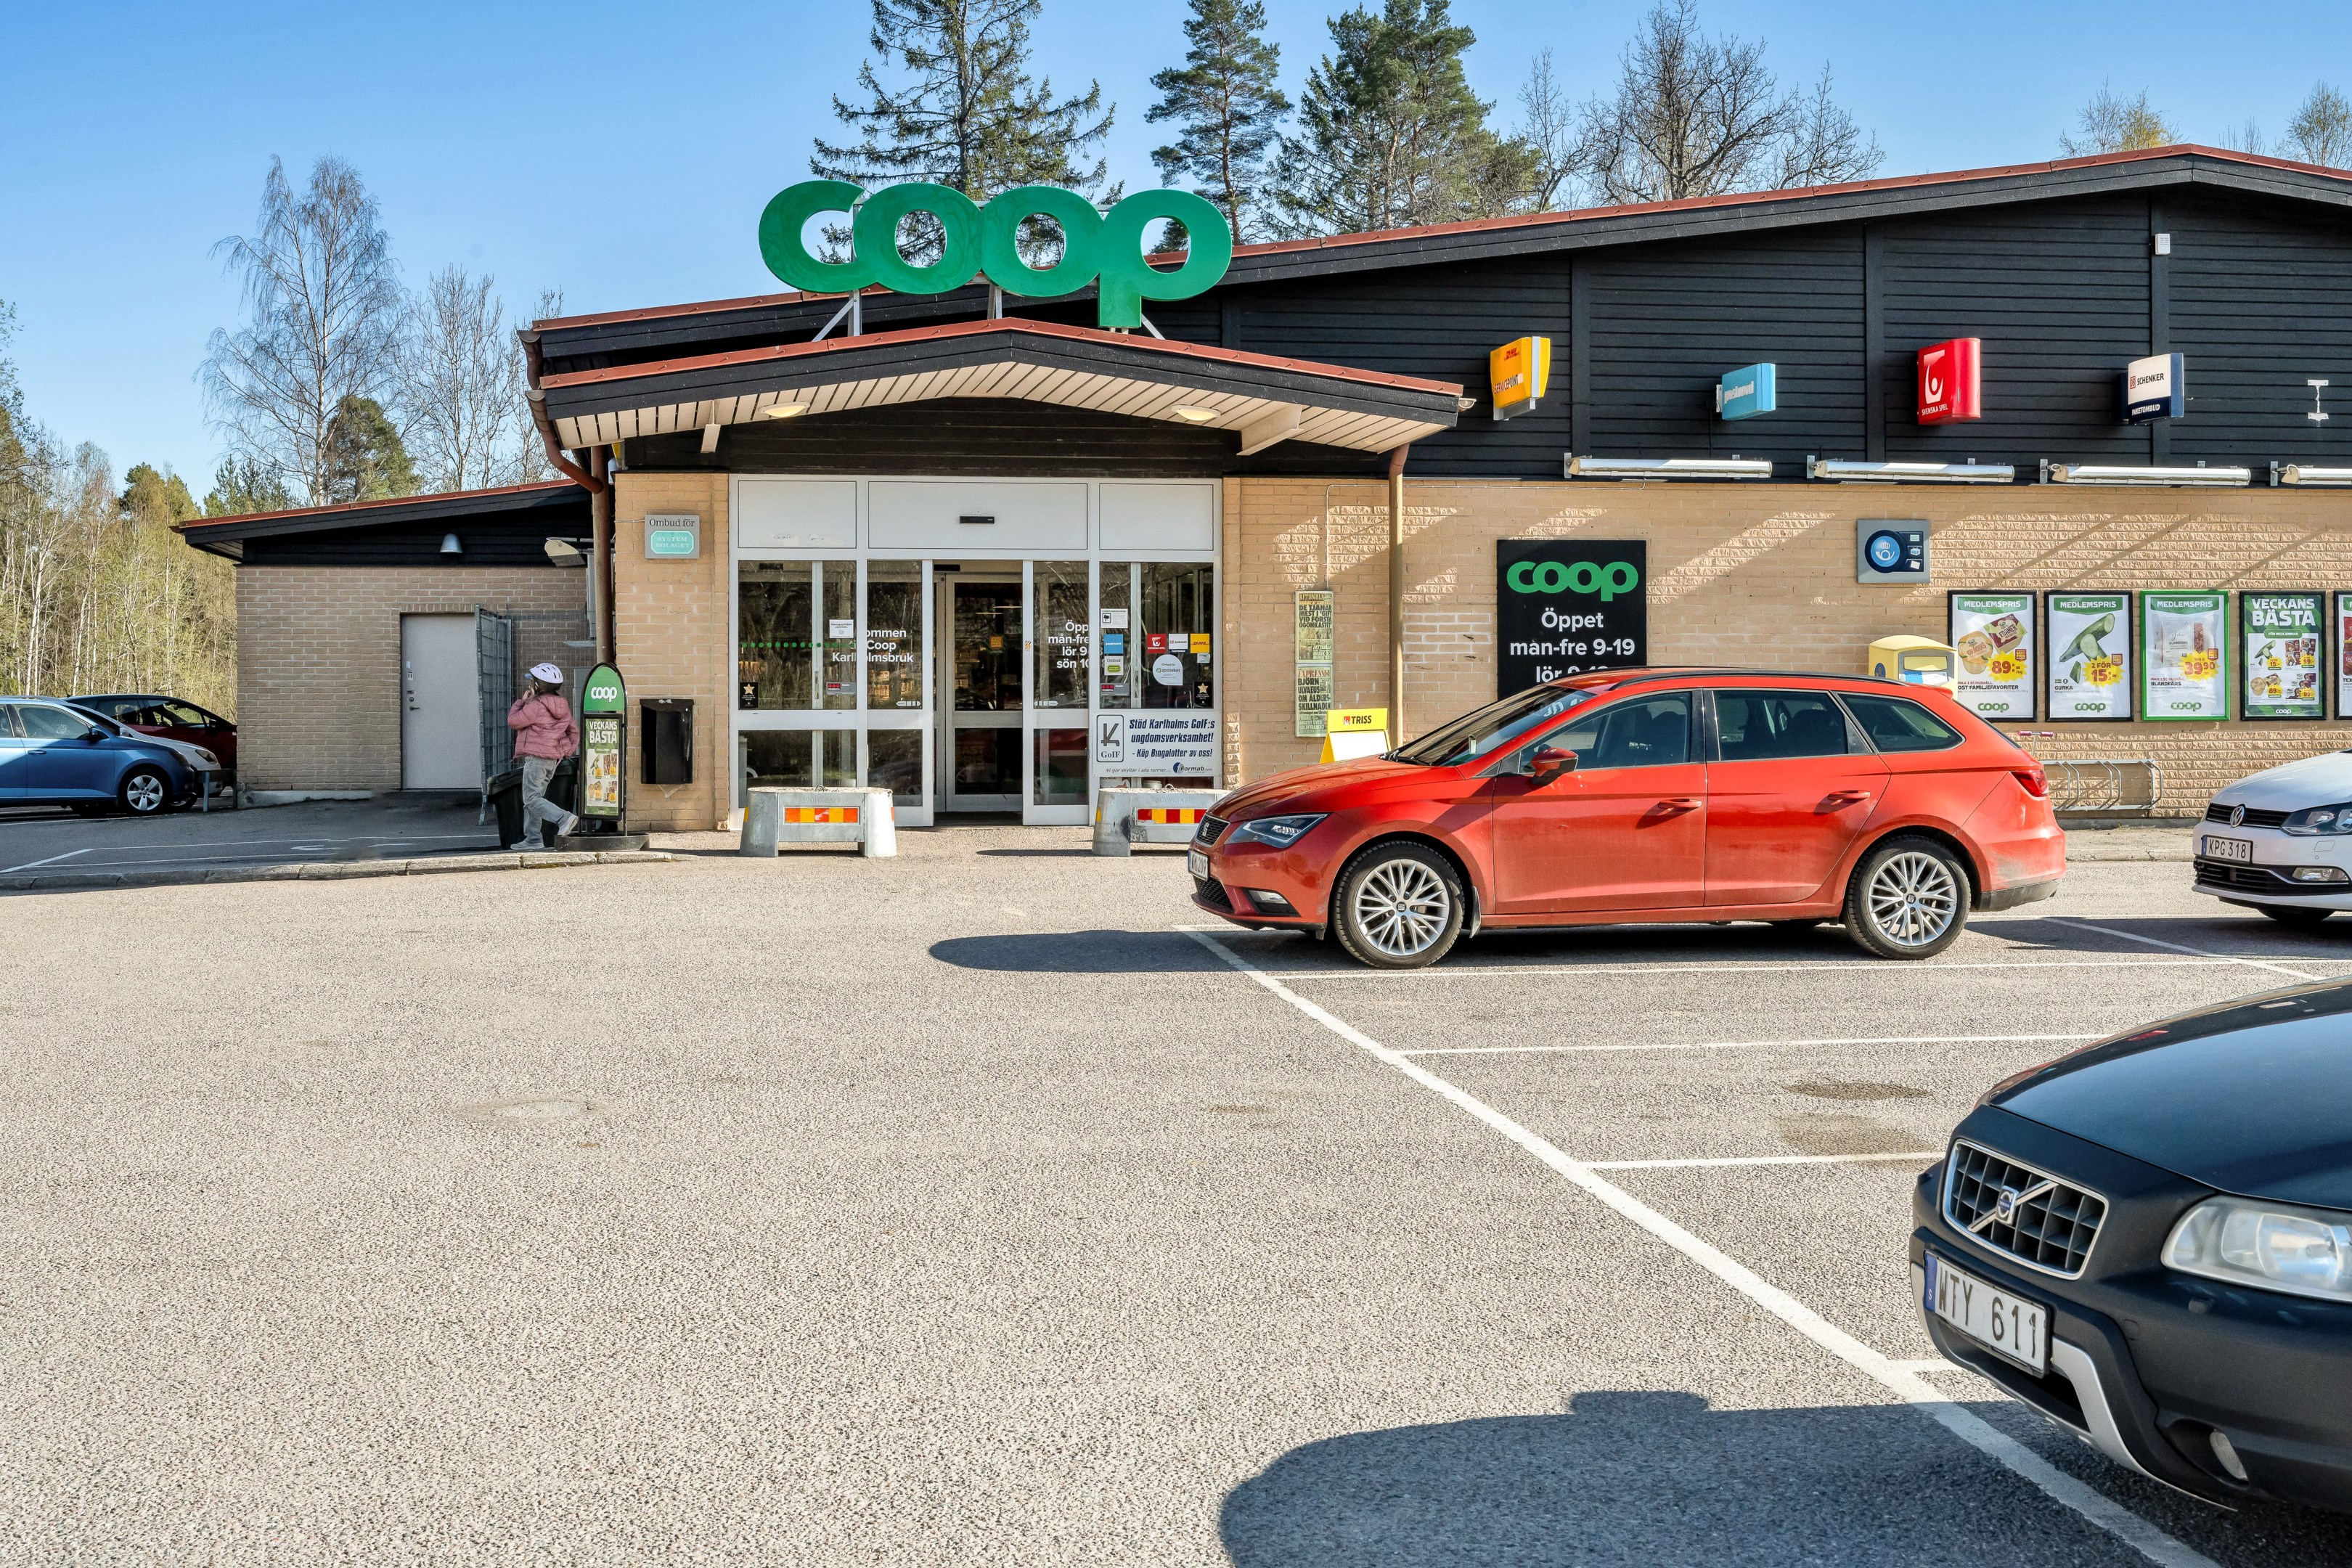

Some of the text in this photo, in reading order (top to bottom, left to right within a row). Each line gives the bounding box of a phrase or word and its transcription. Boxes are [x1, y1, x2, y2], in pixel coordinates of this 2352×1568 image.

[759, 180, 1232, 327] coop
[1505, 348, 1518, 360] DHL
[1494, 374, 1518, 394] SERVICEPOINT
[2137, 373, 2164, 385] SCHENKER
[1922, 406, 1938, 416] SVENSKA
[2131, 404, 2160, 416] PAKETOMBUD
[1506, 561, 1638, 601] coop
[2252, 598, 2315, 609] VECKANS
[1541, 607, 1604, 632] Öppet
[2252, 608, 2316, 626] BÄSTA
[1065, 619, 1089, 633] Öpp
[867, 640, 897, 652] Coop
[1062, 646, 1077, 656] lör
[1593, 638, 1636, 656] 9-19
[1057, 658, 1077, 668] sön
[1536, 666, 1562, 682] lör
[591, 687, 617, 702] coop
[1298, 702, 1331, 711] SKILLNADEN
[1977, 703, 2009, 713] coop
[2075, 703, 2107, 713] coop
[2171, 702, 2202, 711] coop
[1129, 719, 1146, 729] Stöd
[1148, 719, 1189, 729] Karlholms
[1351, 715, 1372, 724] TRISS
[589, 722, 617, 730] VECKANS
[589, 730, 617, 743] BÄSTA
[1131, 732, 1214, 744] ungdomsverksamhet!
[1137, 748, 1149, 759] Köp
[1151, 748, 1188, 759] Bingolotter
[1199, 748, 1212, 757] oss!
[2209, 840, 2246, 859] KPG 318
[1928, 1289, 1932, 1301] S
[1938, 1266, 2036, 1359] WTY 611
